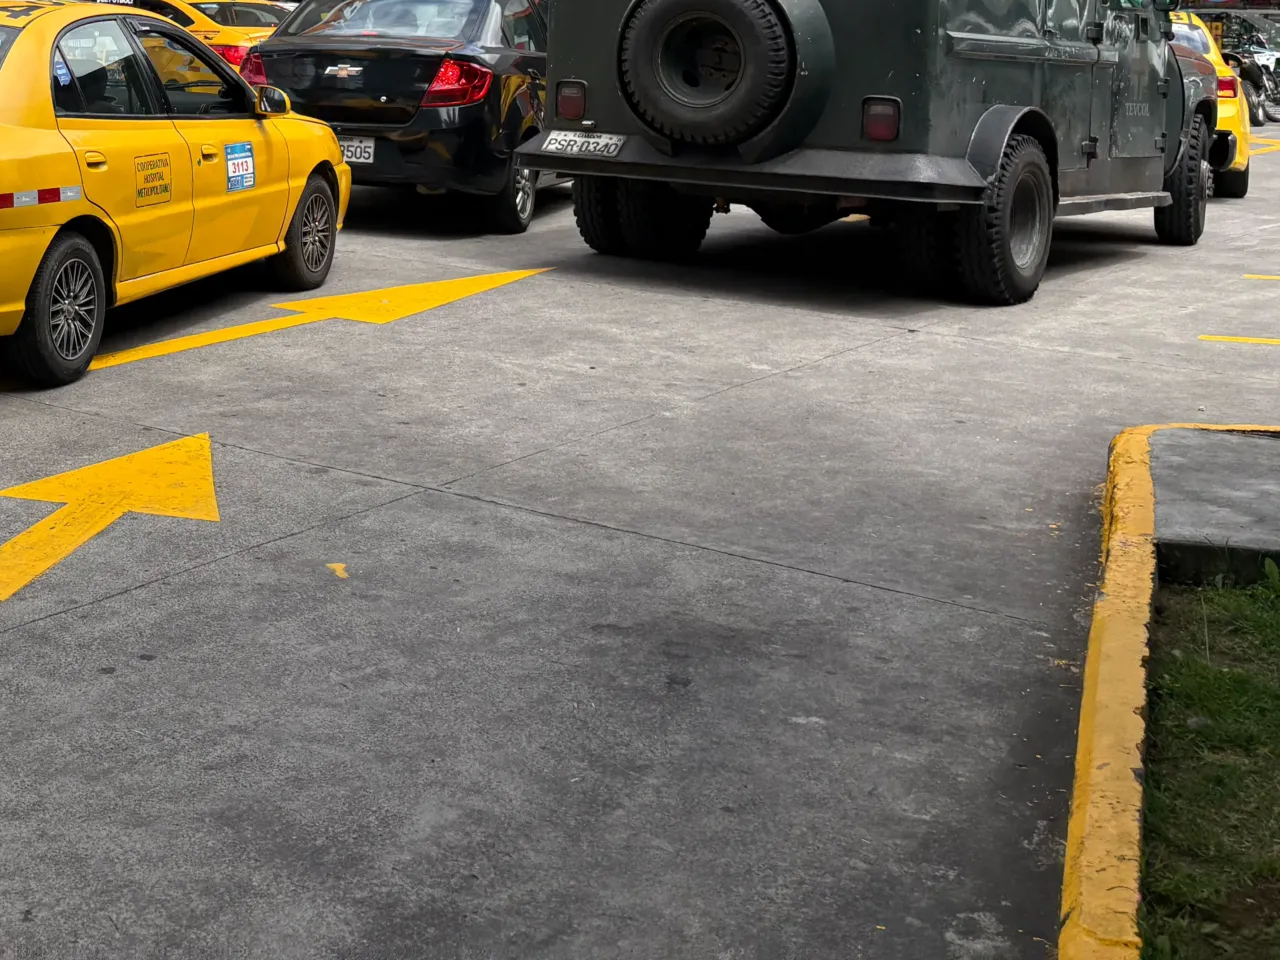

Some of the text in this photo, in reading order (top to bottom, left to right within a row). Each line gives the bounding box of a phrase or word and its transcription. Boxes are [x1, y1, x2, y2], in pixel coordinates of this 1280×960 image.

[1124, 102, 1150, 117] TEVCOL
[544, 137, 619, 155] PSR-0340
[136, 159, 169, 172] COOPERATIVA
[231, 160, 249, 174] 3113
